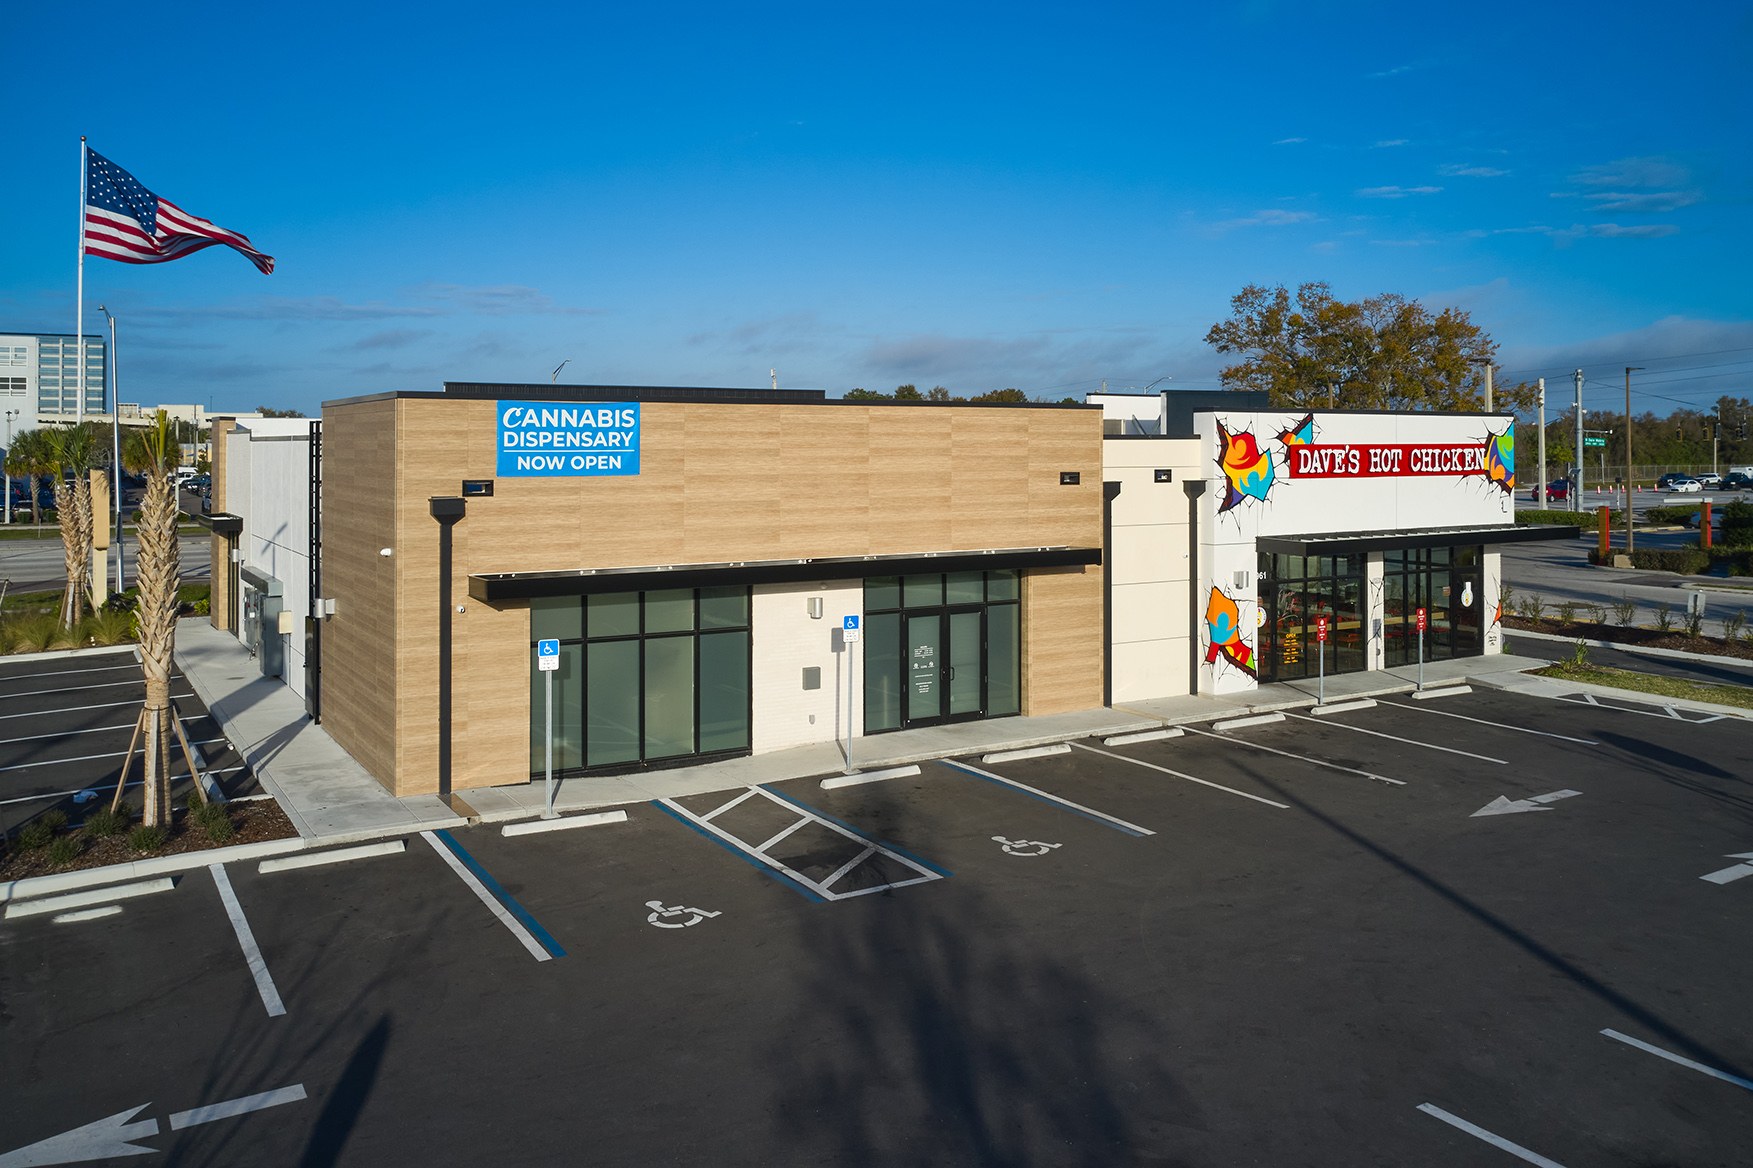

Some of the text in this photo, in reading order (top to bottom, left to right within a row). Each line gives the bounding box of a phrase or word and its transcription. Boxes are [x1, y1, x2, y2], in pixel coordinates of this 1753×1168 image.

[502, 407, 635, 428] CANNABIS
[503, 431, 633, 447] DISPENSARY
[517, 455, 622, 470] NOW OPEN
[1298, 445, 1486, 473] DAVE'S HOT CHICKEN
